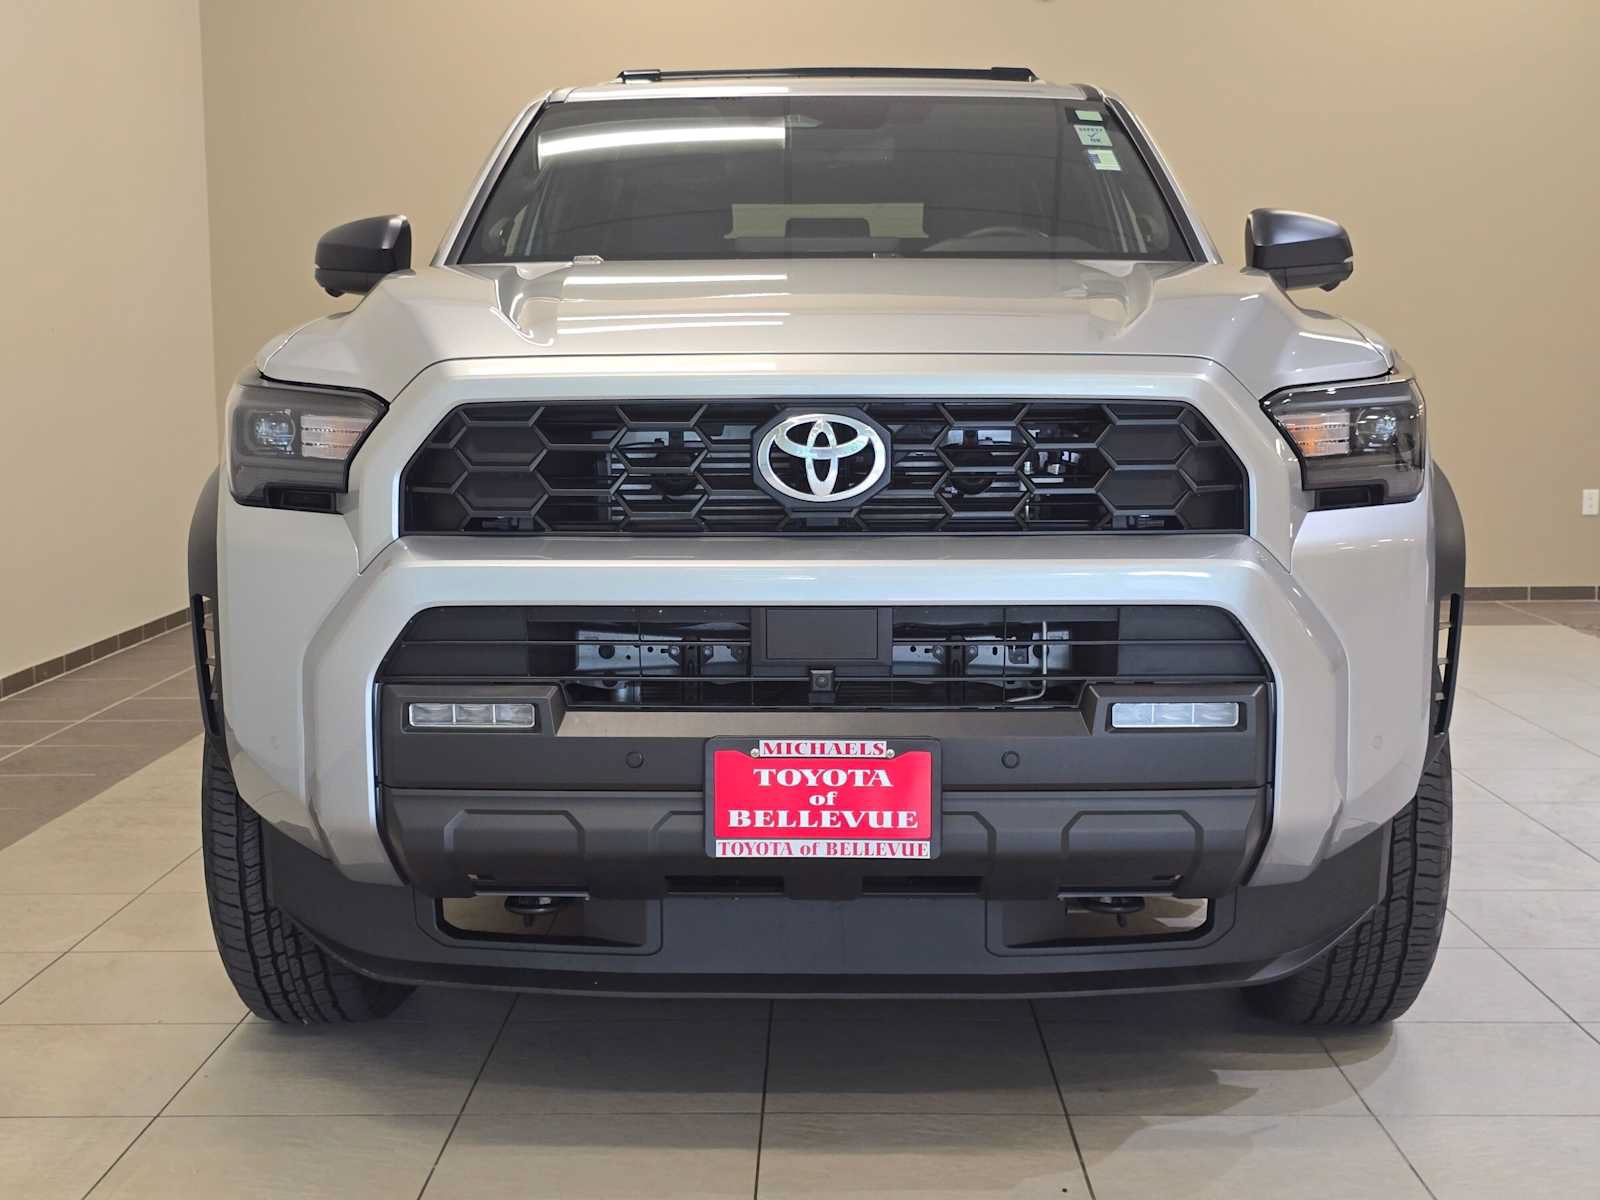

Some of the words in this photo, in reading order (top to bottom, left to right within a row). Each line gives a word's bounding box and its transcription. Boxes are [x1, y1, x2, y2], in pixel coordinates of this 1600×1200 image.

[763, 742, 884, 755] MICHAELS
[753, 769, 892, 787] TOYOTA
[809, 791, 838, 806] of
[728, 810, 918, 828] BELLEVUE
[718, 841, 793, 856] TOYOTA
[800, 841, 819, 856] of
[825, 842, 928, 857] BELLEVUE
